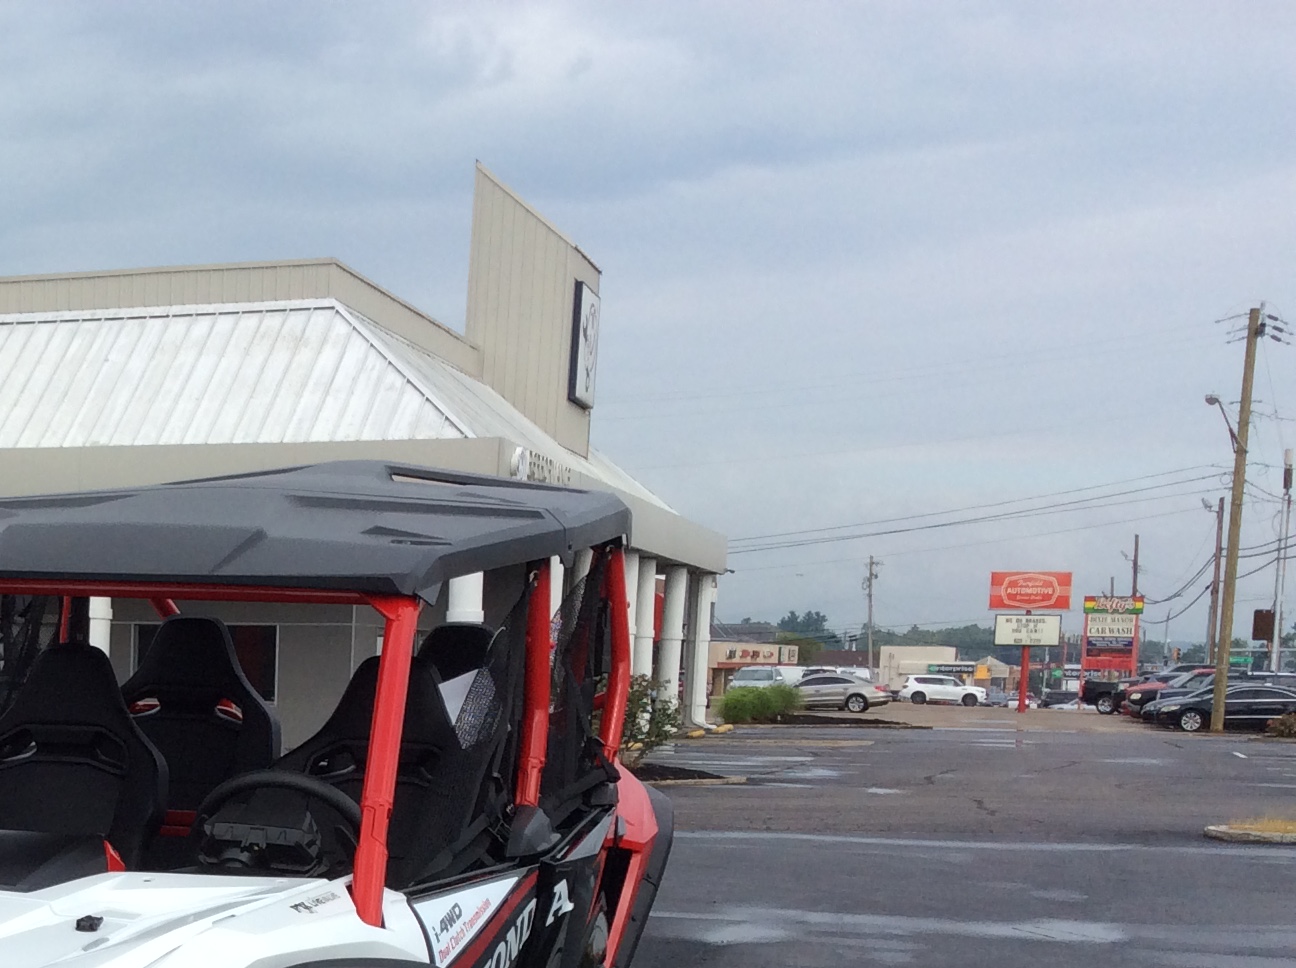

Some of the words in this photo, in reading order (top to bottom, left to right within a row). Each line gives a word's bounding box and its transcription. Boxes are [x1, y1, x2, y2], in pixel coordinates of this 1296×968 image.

[1089, 627, 1106, 635] CAR
[1108, 627, 1132, 635] WASH
[928, 665, 974, 673] enterprise
[432, 902, 463, 943] i-4WD
[438, 942, 452, 964] Dual
[450, 925, 466, 950] Clutch
[463, 898, 492, 932] Transmission
